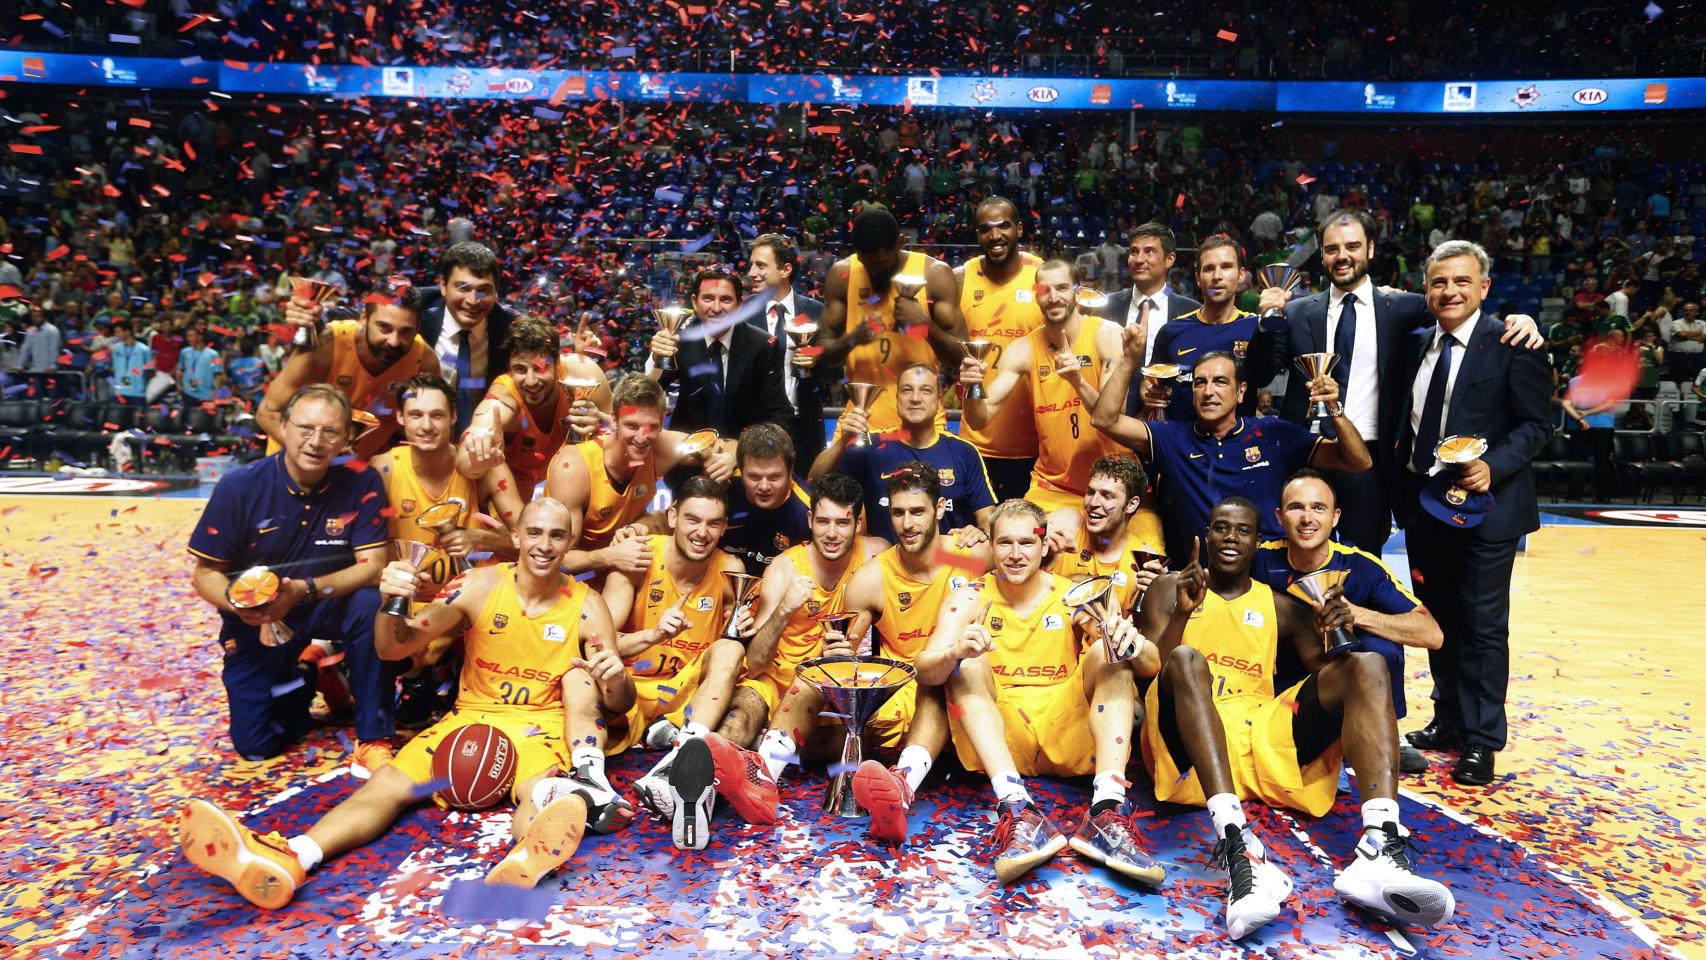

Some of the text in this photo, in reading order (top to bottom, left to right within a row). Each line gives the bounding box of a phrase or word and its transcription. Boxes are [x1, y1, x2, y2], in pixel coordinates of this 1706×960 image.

[1032, 90, 1054, 99] KIA
[1579, 91, 1602, 100] KIA
[880, 337, 891, 364] 9
[1069, 413, 1080, 439] 8
[659, 639, 710, 651] ASSA
[655, 653, 681, 677] 13
[999, 664, 1068, 677] LASSA
[1205, 652, 1263, 675] ASSA
[499, 681, 530, 705] 30
